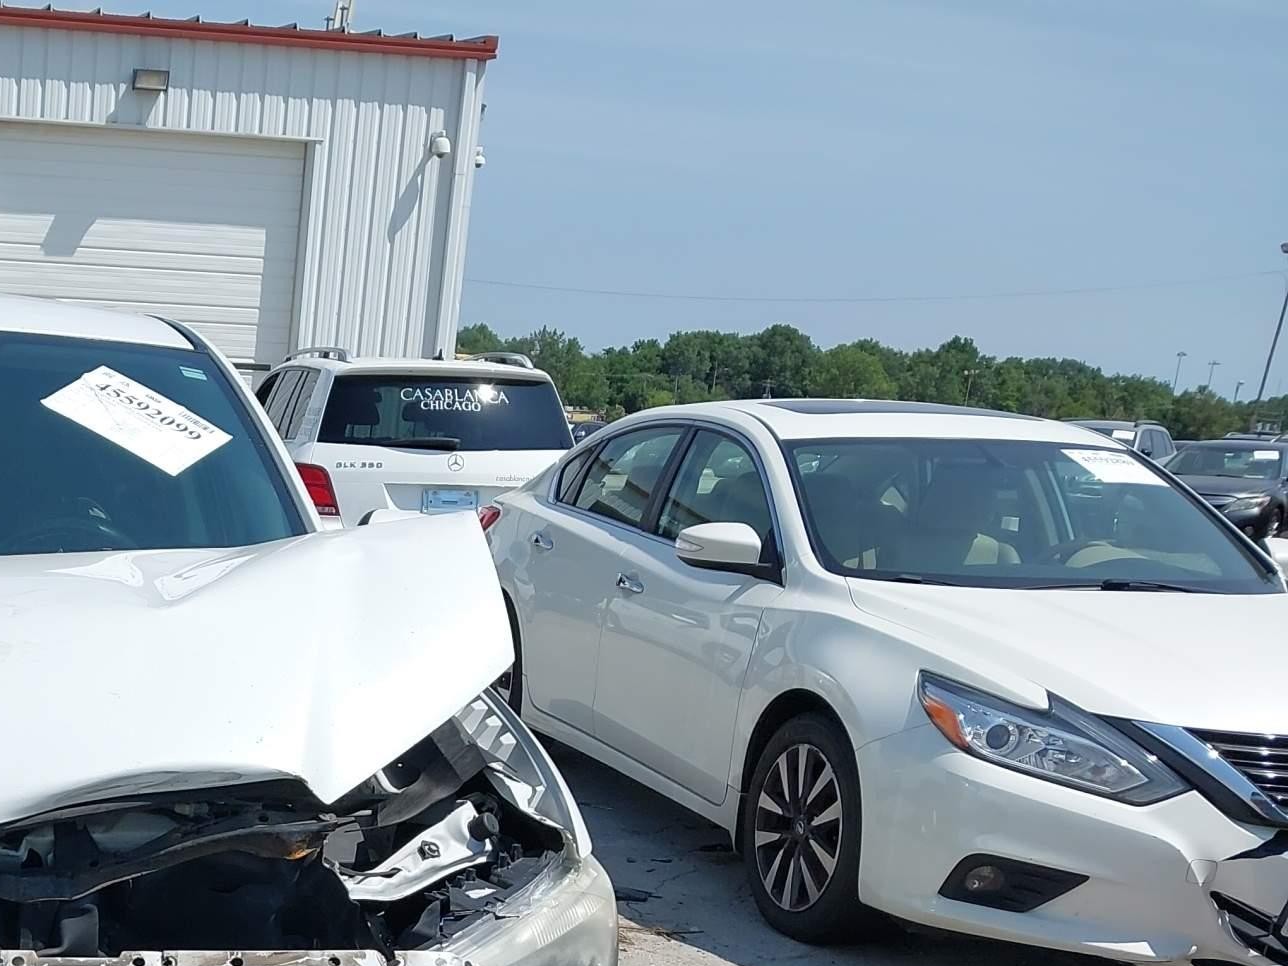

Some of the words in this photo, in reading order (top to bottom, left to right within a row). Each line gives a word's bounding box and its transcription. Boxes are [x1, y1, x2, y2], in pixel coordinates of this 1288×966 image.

[400, 387, 510, 404] CASABLANCA
[95, 382, 202, 440] 45592099
[420, 400, 481, 411] CHICAGO
